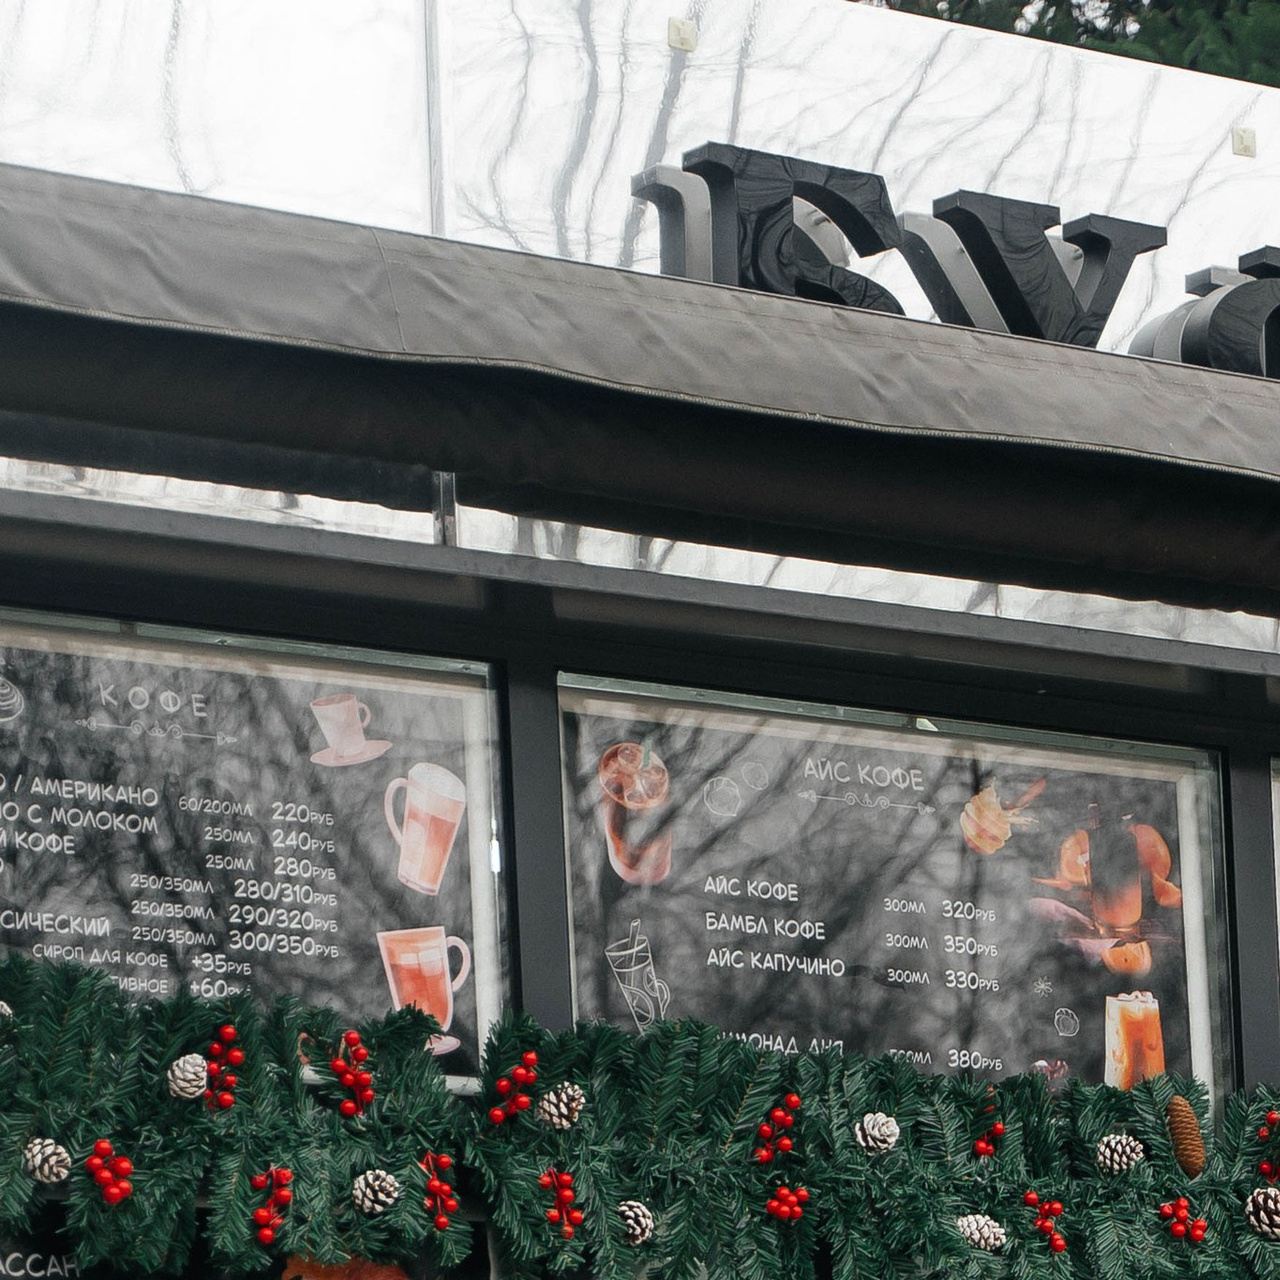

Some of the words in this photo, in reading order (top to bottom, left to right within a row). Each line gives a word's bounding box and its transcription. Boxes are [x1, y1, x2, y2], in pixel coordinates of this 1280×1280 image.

[99, 684, 208, 718] КОФЕ
[804, 758, 851, 783] АЙС
[857, 763, 925, 791] КОФЕ
[30, 776, 158, 807] АМЕРИКАНО
[178, 796, 253, 816] 60/200МЛ
[271, 801, 335, 826] 220РУБ
[27, 804, 43, 823] С
[49, 807, 159, 834] МОЛОКОМ
[204, 826, 254, 843] 250МЛ
[272, 828, 336, 853] 240РУБ
[15, 831, 76, 854] КОФЕ
[205, 854, 255, 871] 250МЛ
[273, 856, 337, 880] 280РУБ
[130, 873, 214, 894] 250/350МЛ
[234, 878, 338, 907] 280/310РУБ
[704, 876, 740, 896] АЙС
[747, 880, 799, 901] КОФЕ
[883, 897, 926, 915] 300МЛ
[942, 900, 997, 922] 320РУБ
[131, 900, 215, 920] 250/350МЛ
[228, 904, 338, 933] 290/320РУБ
[132, 926, 216, 946] 250/350МЛ
[229, 930, 339, 958] 300/350РУБ
[705, 912, 768, 935] БАМБЛ
[774, 918, 826, 941] КОФЕ
[885, 933, 929, 950] 300МЛ
[944, 935, 998, 957] 350РУБ
[32, 943, 84, 961] СИРОП
[89, 948, 121, 965] ДЛЯ
[126, 951, 168, 968] КОФЕ
[192, 952, 252, 975] +35РУБ
[707, 948, 744, 969] АЙС
[751, 951, 846, 977] КАПУЧИНО
[887, 968, 931, 985] 300МЛ
[945, 969, 1000, 993] 330РУБ
[947, 1049, 1003, 1071] 380РУБ
